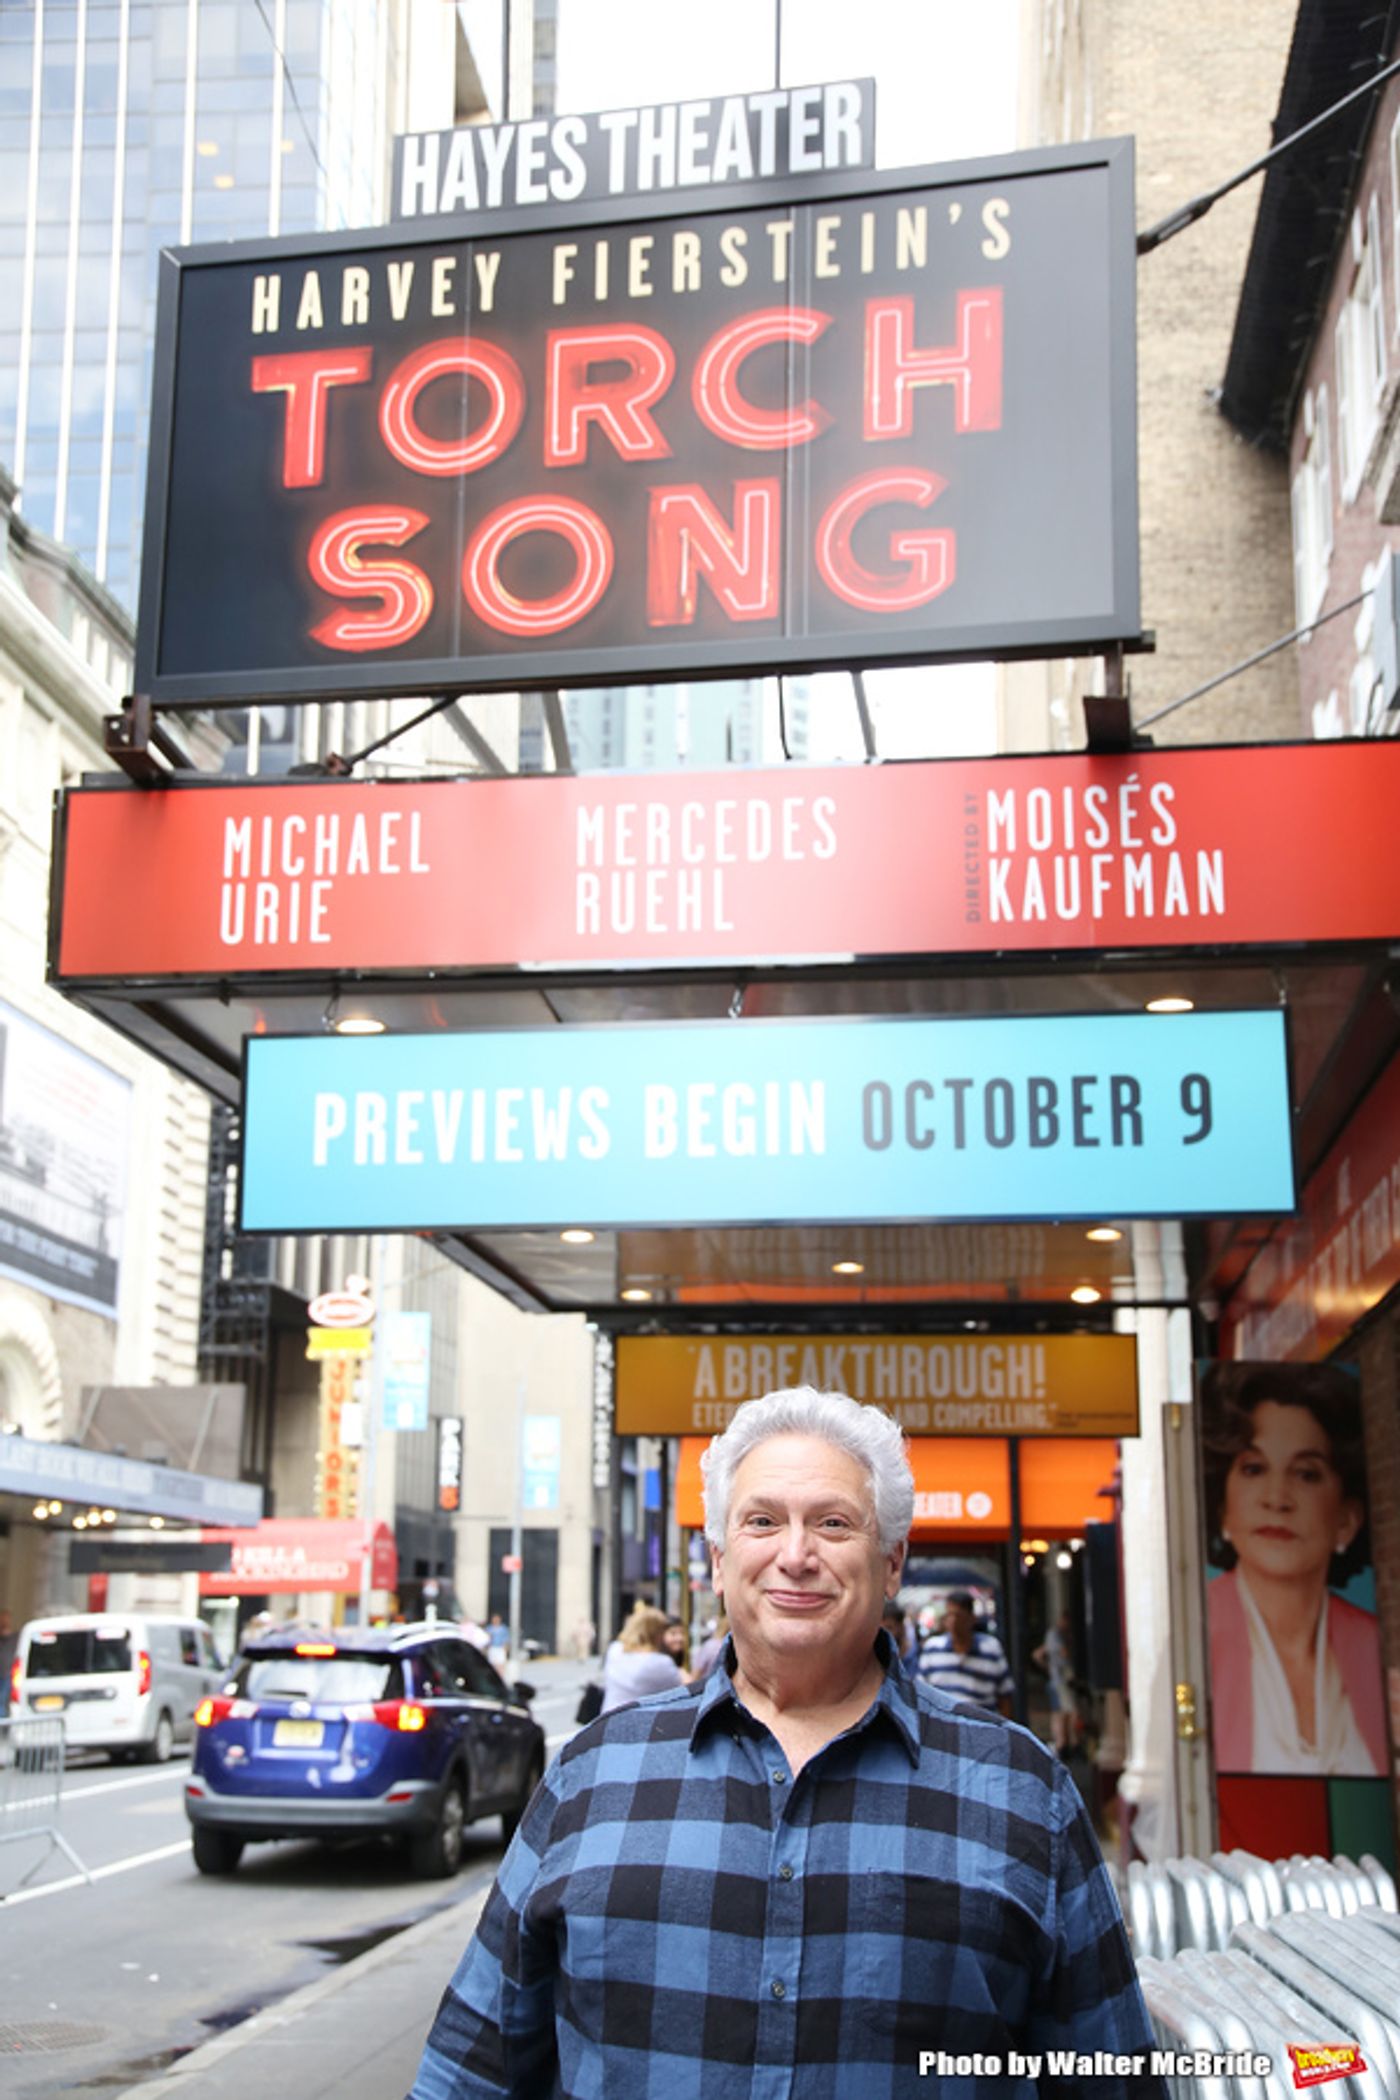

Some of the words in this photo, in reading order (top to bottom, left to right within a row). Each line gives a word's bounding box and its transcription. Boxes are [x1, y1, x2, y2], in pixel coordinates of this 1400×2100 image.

[401, 116, 588, 217] HAYES
[600, 82, 863, 194] THEATER
[251, 252, 501, 333] HARVEY
[552, 198, 1012, 304] FIERSTEIN'S
[251, 287, 1003, 489] TORCH
[307, 466, 957, 652] SONG
[223, 811, 430, 879] MICHAEL
[576, 796, 839, 867] MERCEDES
[987, 772, 1177, 853] MOISÉS
[219, 880, 333, 945] URIE
[576, 868, 735, 935] RUEHL
[964, 823, 981, 924] DIRECTED
[988, 849, 1226, 923] KAUFMAN
[312, 1085, 611, 1167] PREVIEWS
[643, 1079, 827, 1160] BEGIN
[862, 1074, 1144, 1152] OCTOBER
[1179, 1072, 1213, 1146] 9
[723, 1343, 1046, 1399] BREAKTHROUGH!
